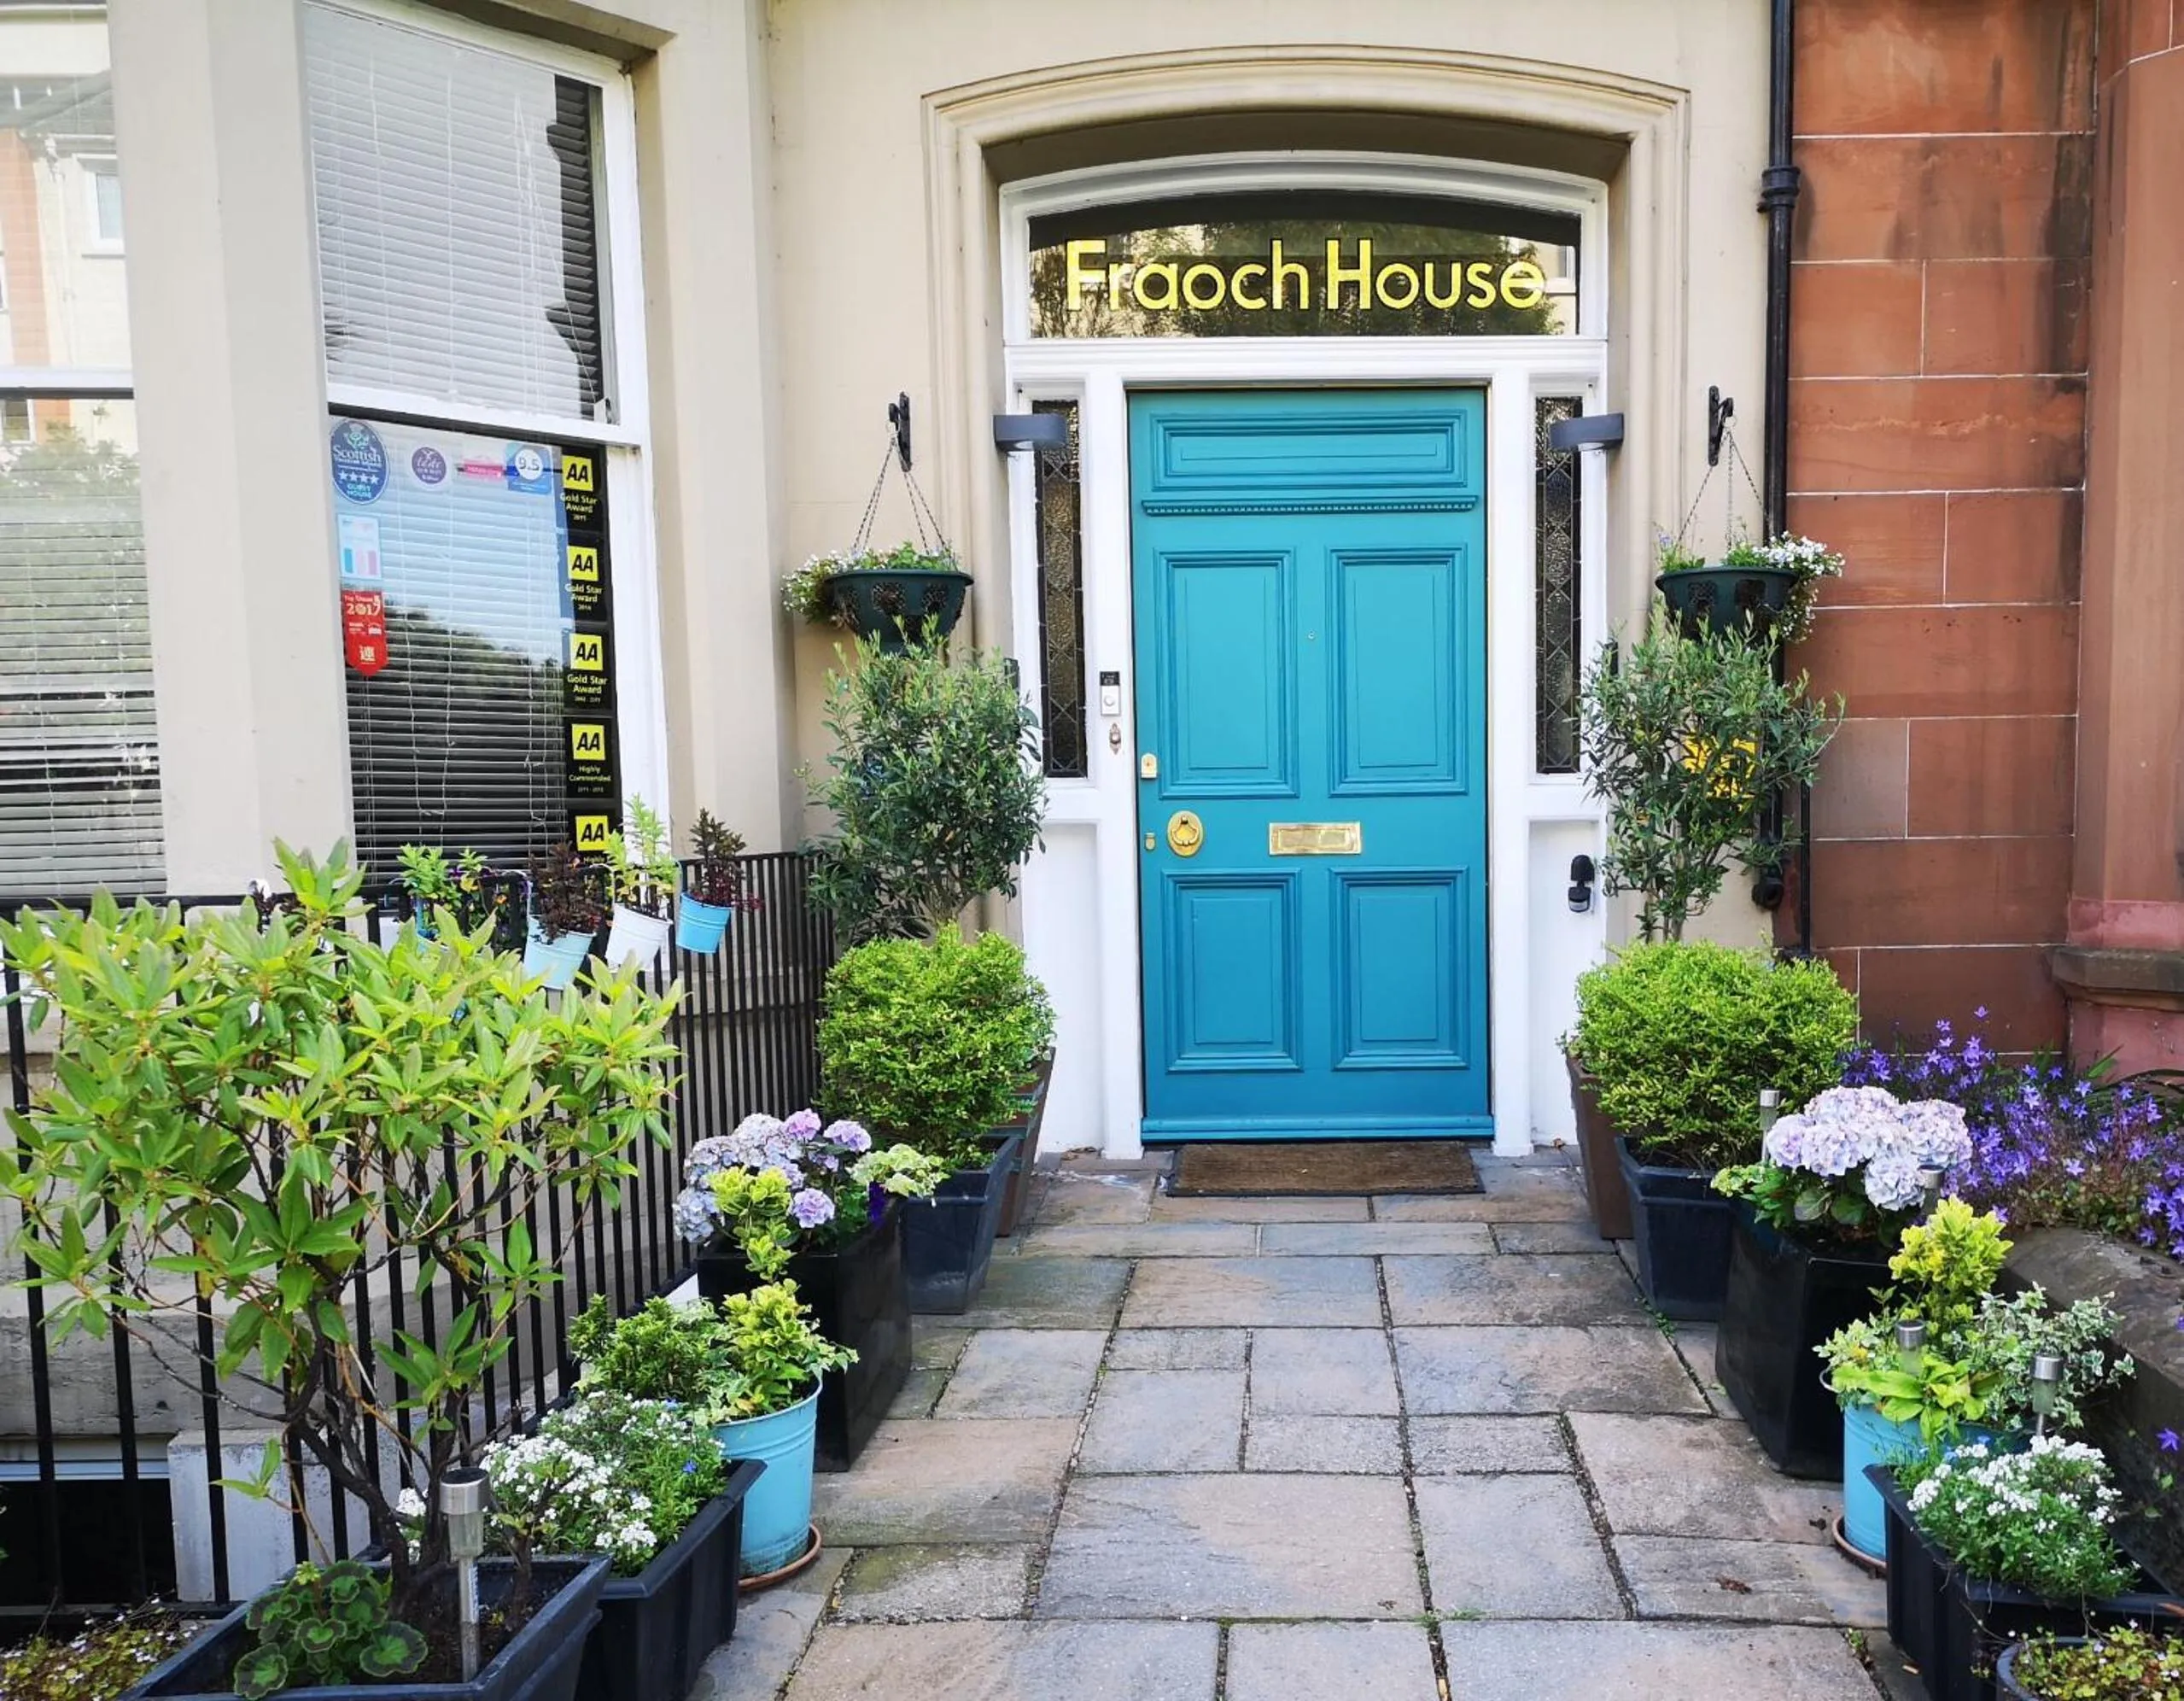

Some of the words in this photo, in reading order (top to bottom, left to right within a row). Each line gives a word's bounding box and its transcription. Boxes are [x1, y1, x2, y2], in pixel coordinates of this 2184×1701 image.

[1065, 238, 1309, 311] Fraoch
[1326, 238, 1546, 311] House
[333, 445, 382, 462] Scottish
[518, 456, 540, 471] 9.5
[566, 462, 589, 482] AA
[560, 491, 580, 503] Gold
[581, 495, 598, 505] Star
[566, 503, 593, 513] Award
[571, 553, 593, 572] AA
[564, 583, 585, 593] Gold
[586, 584, 603, 594] Star
[571, 593, 598, 602] Award
[346, 602, 381, 616] 2017
[575, 641, 598, 661] AA
[567, 673, 587, 683] Gold
[590, 675, 609, 685] Star
[573, 684, 602, 694] Award
[576, 732, 600, 751] AA
[579, 765, 601, 774] Highly
[581, 823, 604, 842] AA
